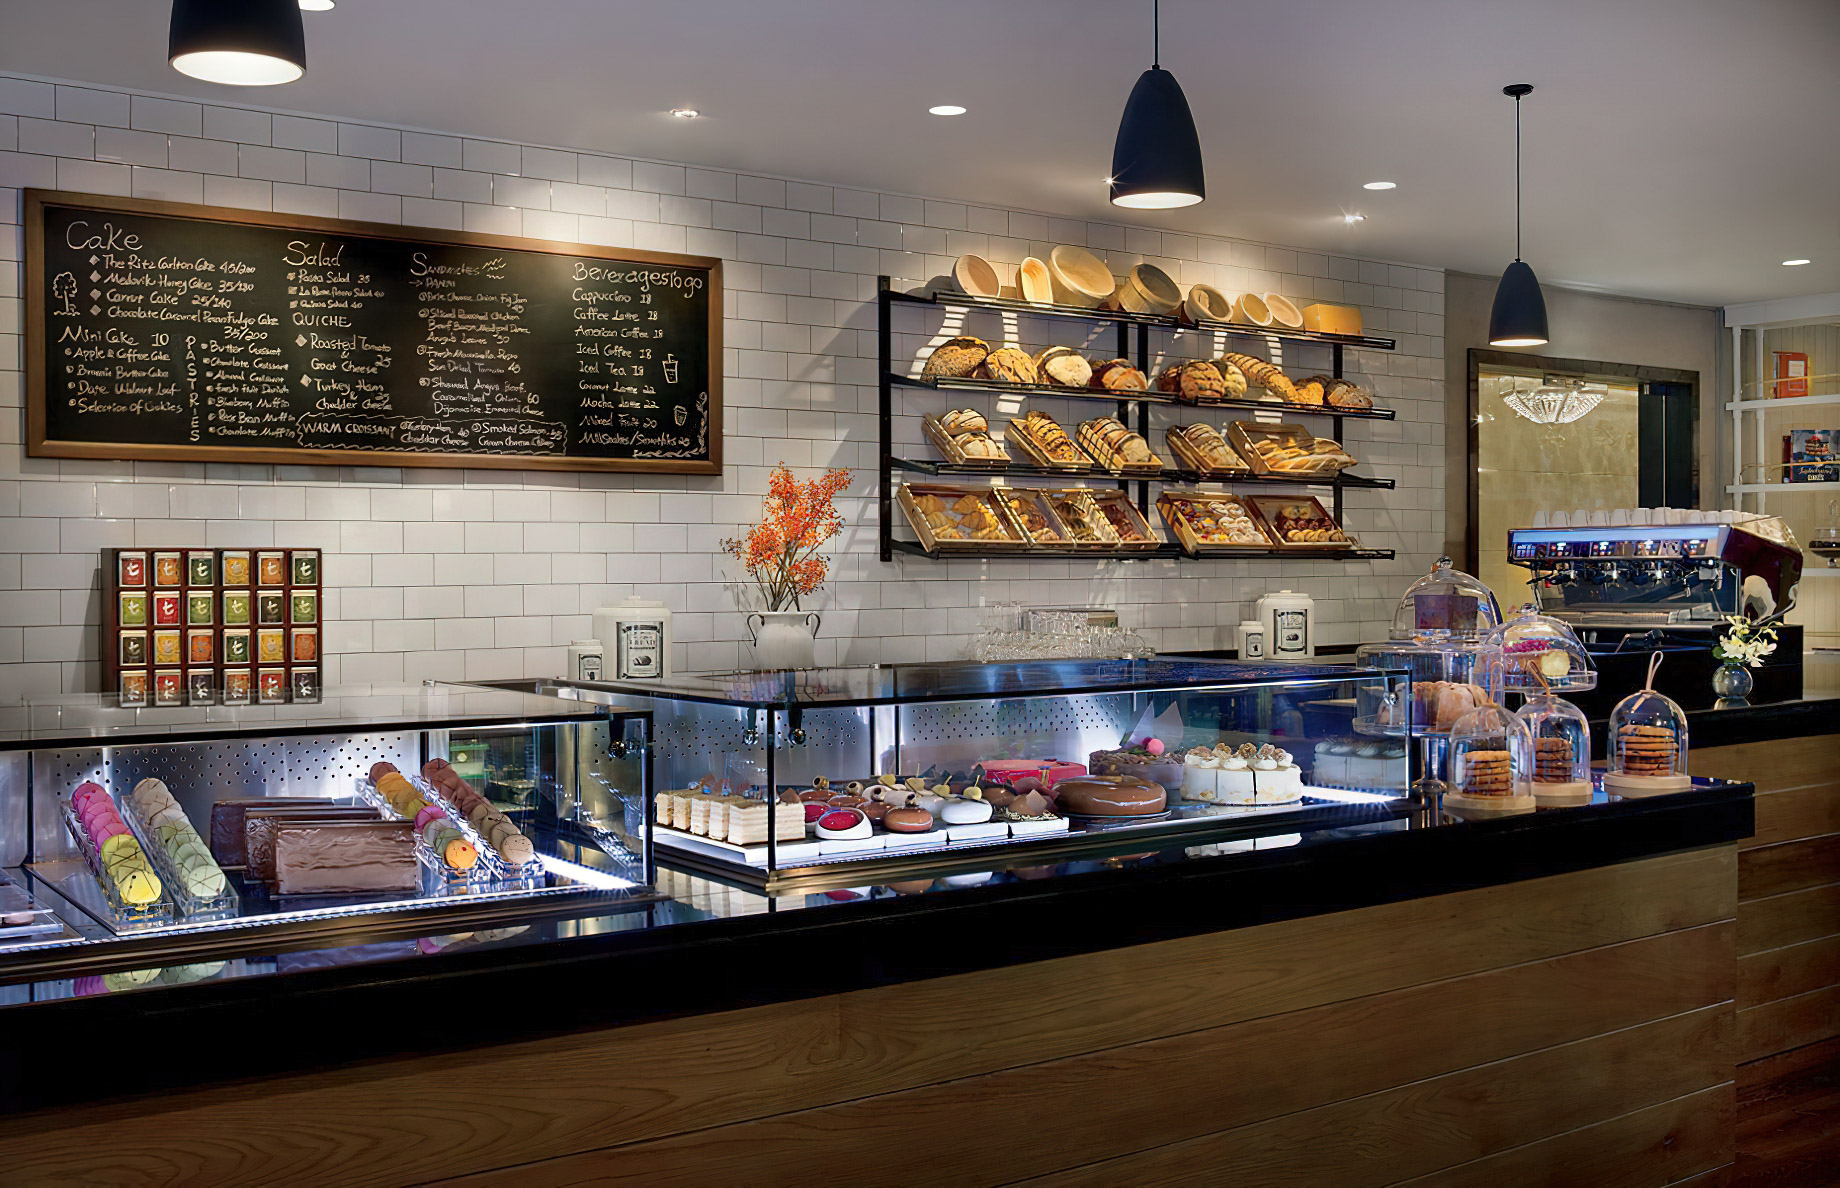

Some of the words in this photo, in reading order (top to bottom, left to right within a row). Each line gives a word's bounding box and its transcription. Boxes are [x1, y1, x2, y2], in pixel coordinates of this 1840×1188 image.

[66, 220, 143, 251] Cake
[281, 240, 345, 267] Salad
[102, 253, 125, 269] The
[127, 254, 156, 270] Ritz
[158, 256, 194, 270] Carlton
[195, 258, 216, 272] Cake
[297, 268, 324, 284] Pasta
[326, 271, 351, 284] Salad
[572, 262, 669, 292] Beverages
[683, 276, 703, 299] go
[157, 274, 187, 296] Honey
[188, 276, 213, 291] Cake
[150, 290, 179, 305] Cake
[572, 287, 632, 305] Cappuccino
[107, 305, 160, 319] Chocolate
[257, 312, 280, 326] Cake
[291, 311, 353, 328] QUICHE
[57, 325, 102, 343] Mini
[105, 327, 140, 346] Cake
[151, 332, 170, 347] 10
[223, 325, 269, 341] 35/200
[574, 325, 618, 337] American
[620, 327, 650, 339] Coffee
[653, 329, 664, 339] 18
[209, 339, 245, 354] Butter
[309, 332, 357, 351] Roasted
[357, 335, 392, 352] Tomato
[72, 345, 106, 362] Apple
[576, 342, 600, 356] Iced
[603, 344, 632, 358] Coffee
[639, 348, 652, 360] 18
[310, 358, 337, 371] Goat
[341, 360, 379, 375] Cheese
[579, 360, 600, 374] Iced
[605, 362, 627, 376] Tea
[314, 378, 352, 396] Turkey
[355, 378, 385, 392] Ham
[78, 397, 128, 414] Selection
[129, 399, 144, 415] of
[144, 401, 183, 414] Cookies
[256, 397, 291, 409] Muffin
[527, 392, 541, 405] 60
[580, 393, 615, 409] Mocha
[643, 399, 660, 409] 22
[260, 427, 297, 439] Muffin
[302, 422, 343, 434] WARM
[344, 423, 397, 440] CROISSANT
[482, 422, 519, 434] Smoked
